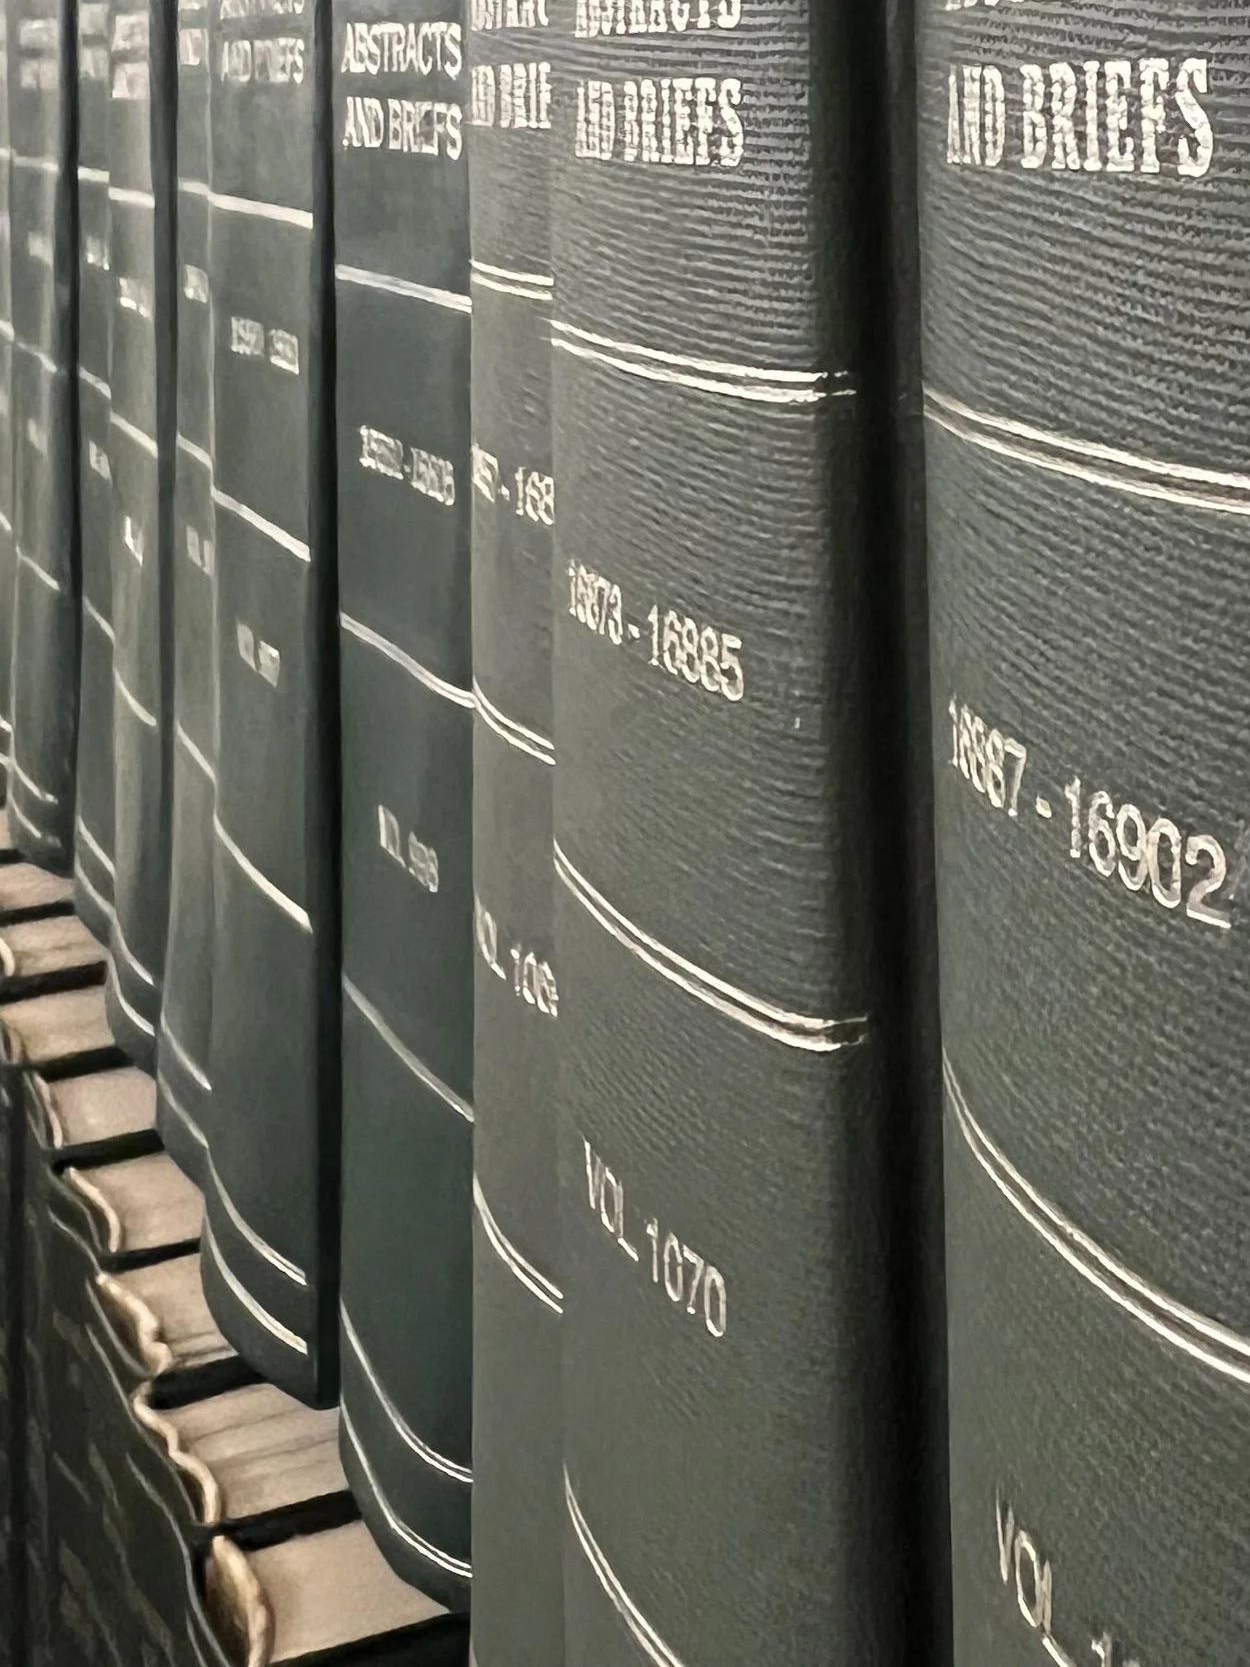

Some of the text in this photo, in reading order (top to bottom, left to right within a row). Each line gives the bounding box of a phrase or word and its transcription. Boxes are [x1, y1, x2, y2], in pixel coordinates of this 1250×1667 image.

[341, 21, 462, 80] ABSTRACTS
[342, 96, 384, 148] AND
[574, 77, 744, 167] AND BRIEFS
[947, 58, 1214, 178] AND BRIEFS
[646, 1216, 728, 1337] 1070
